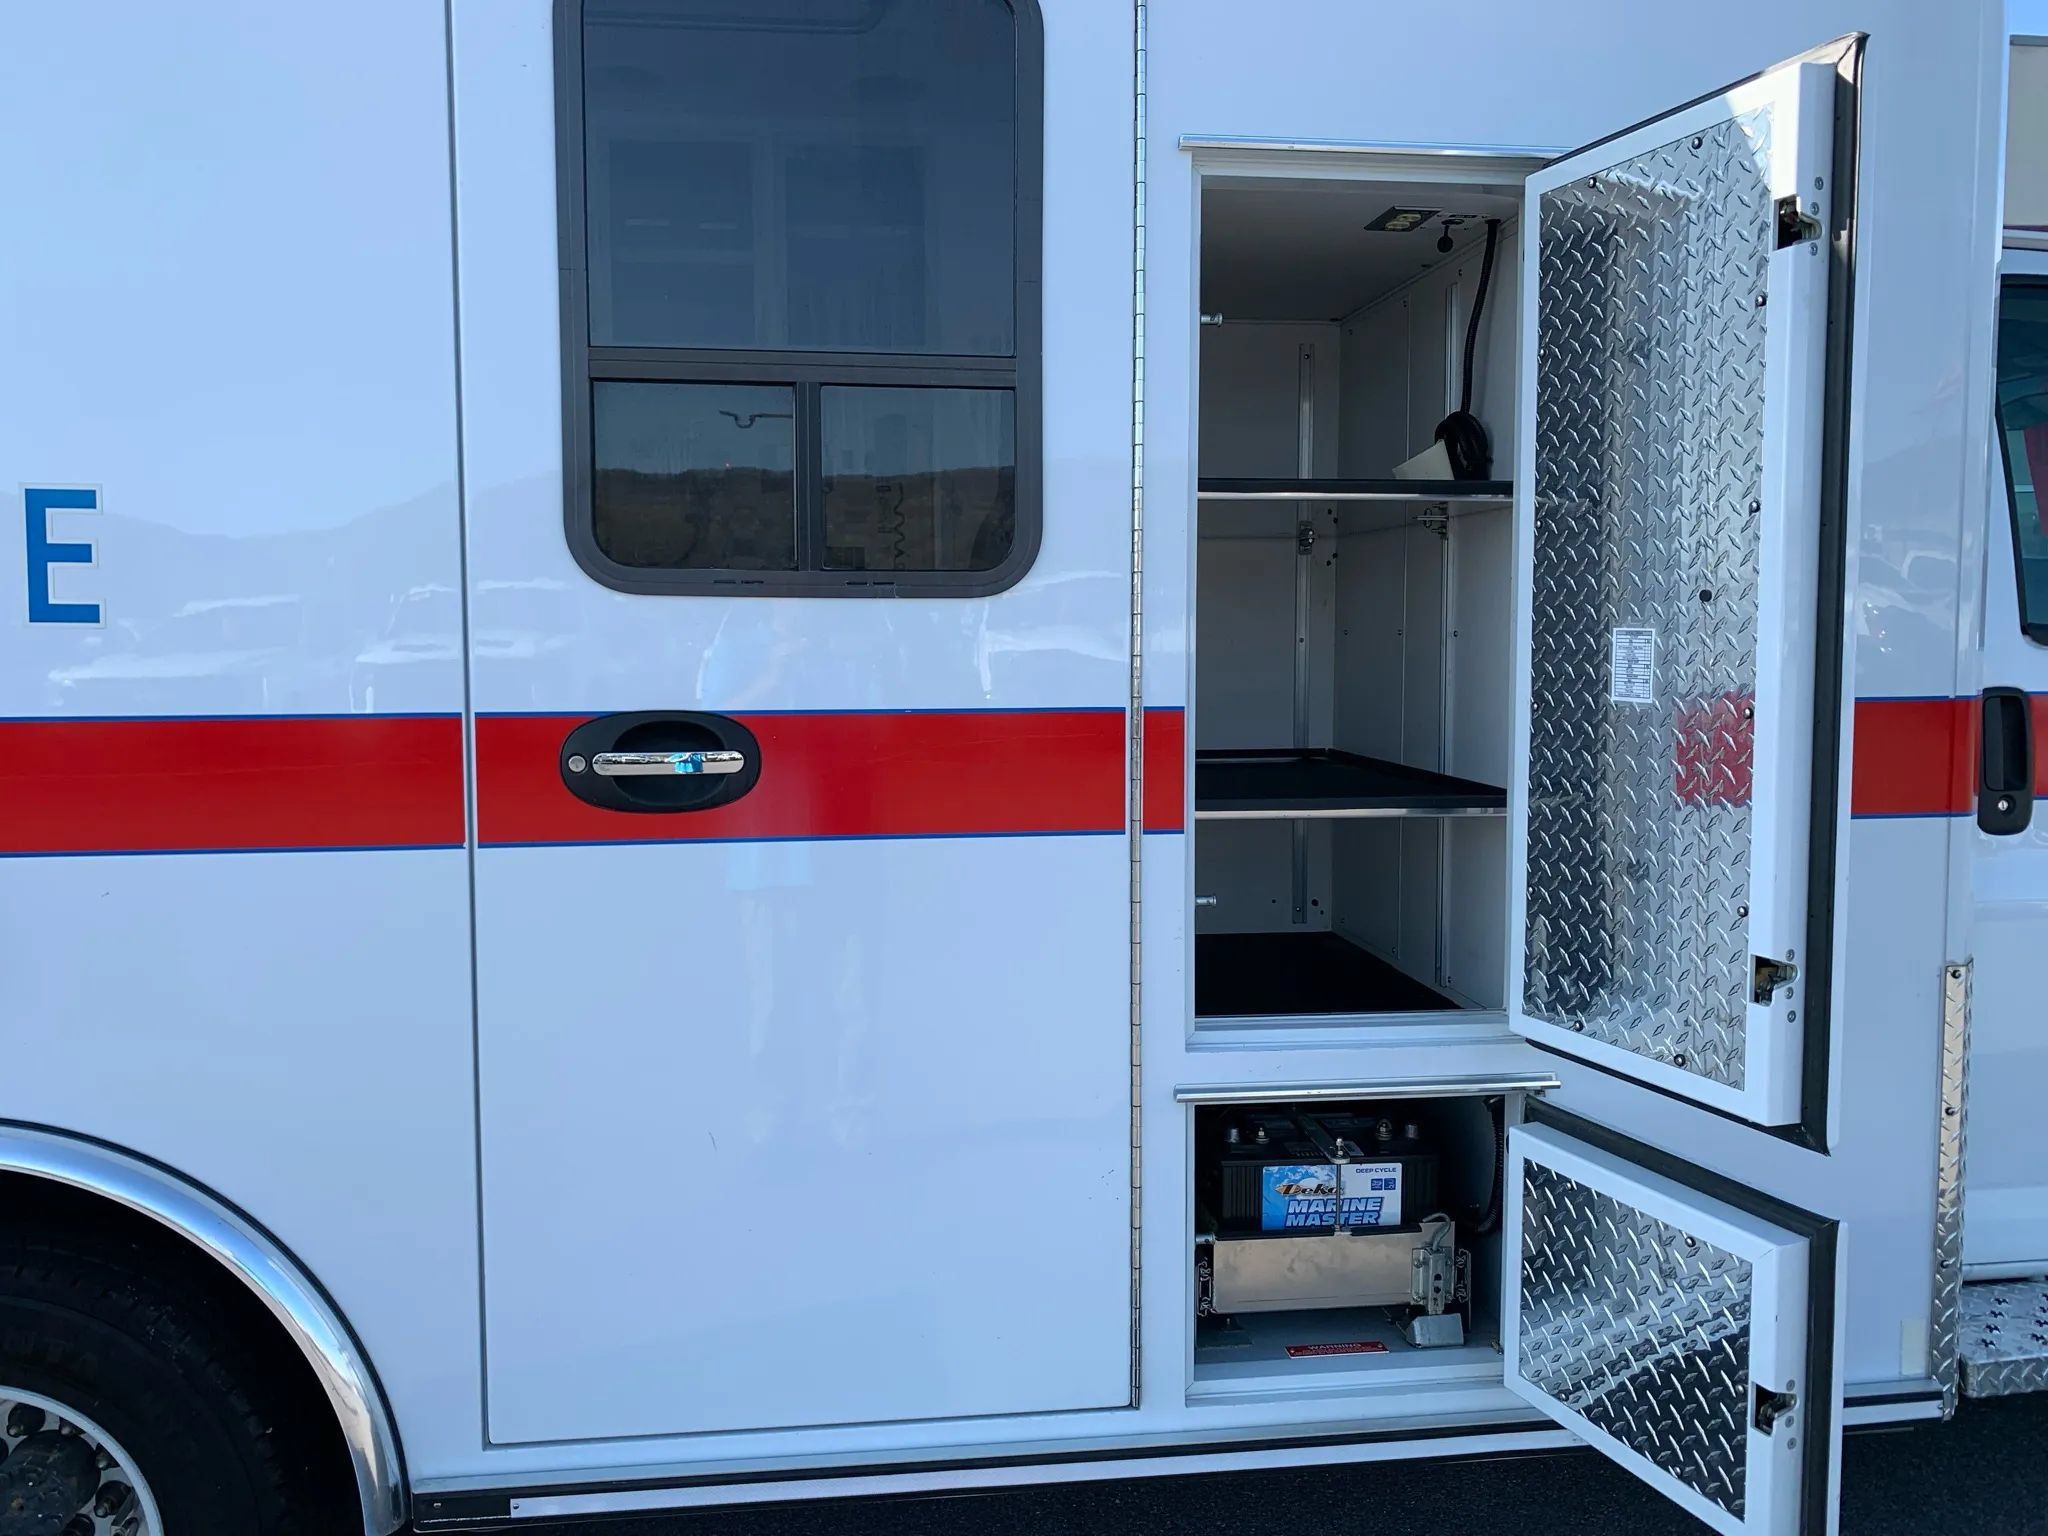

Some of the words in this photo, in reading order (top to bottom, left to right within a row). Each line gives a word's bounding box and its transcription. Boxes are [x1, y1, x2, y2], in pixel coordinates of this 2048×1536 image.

[24, 487, 101, 624] E
[1287, 1198, 1382, 1213] MARINE
[1285, 1212, 1379, 1226] MASTER
